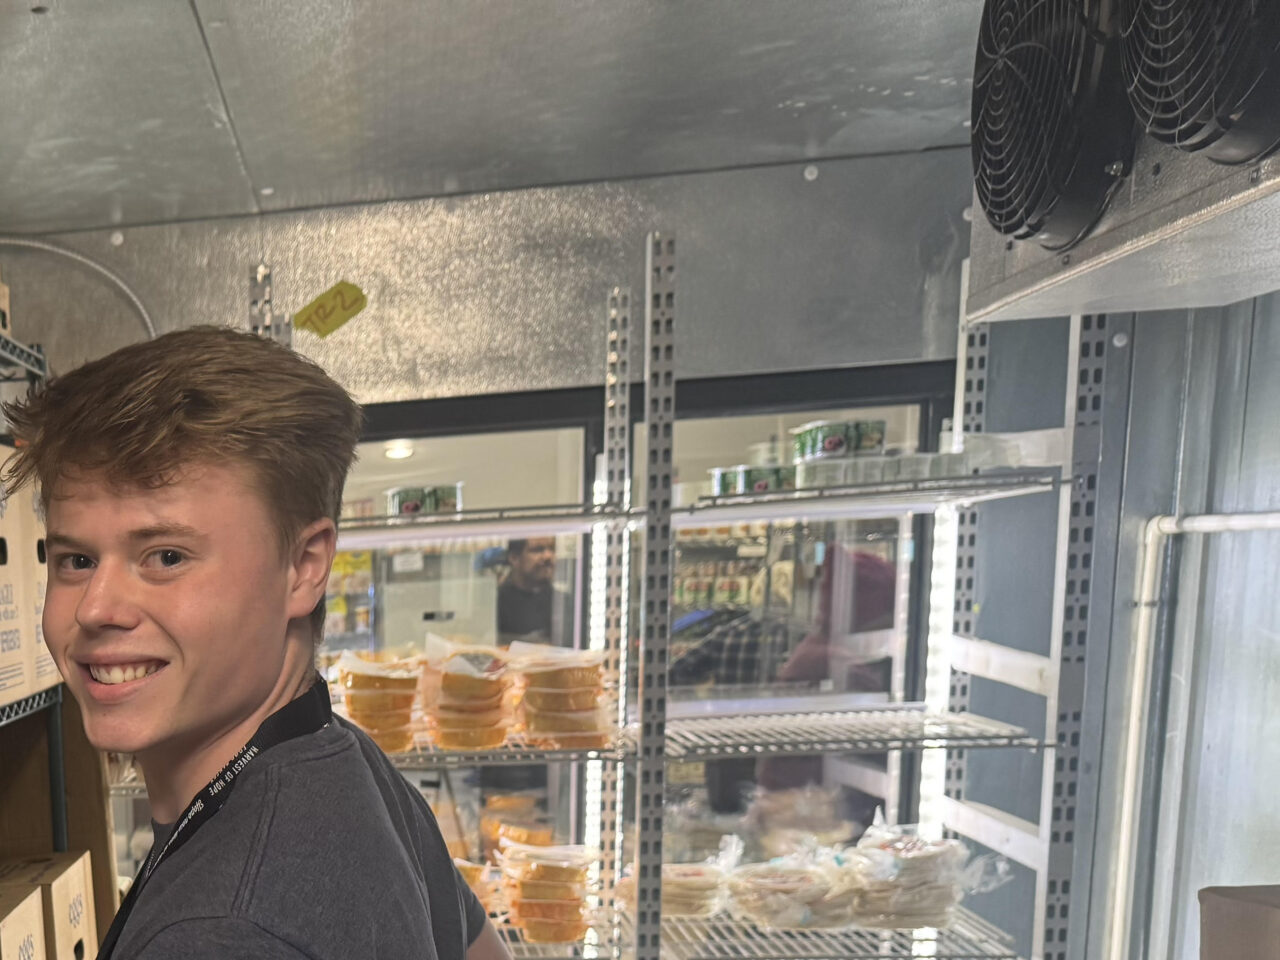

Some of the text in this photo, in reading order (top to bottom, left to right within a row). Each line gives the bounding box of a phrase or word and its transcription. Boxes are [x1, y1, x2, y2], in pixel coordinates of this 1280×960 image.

[208, 745, 260, 796] HARVEST OF HOPE
